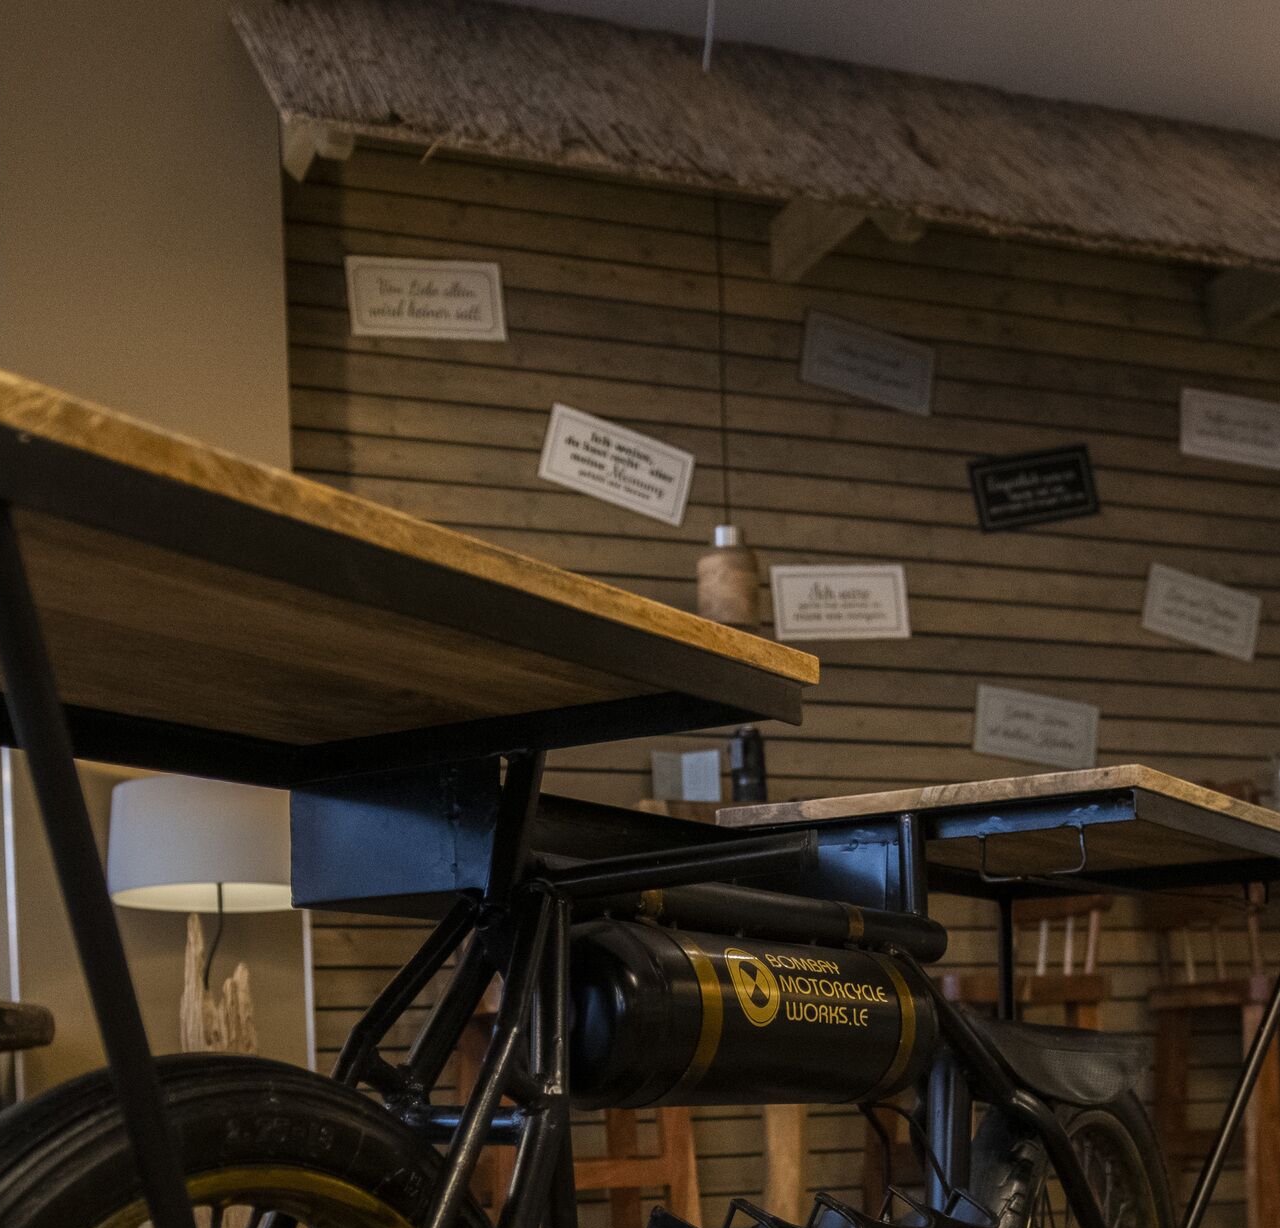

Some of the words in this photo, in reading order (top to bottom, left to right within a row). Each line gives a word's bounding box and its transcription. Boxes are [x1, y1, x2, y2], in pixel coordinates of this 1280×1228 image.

[564, 434, 580, 448] du
[583, 440, 607, 458] hast
[590, 431, 611, 448] Ich
[764, 953, 841, 975] BOMBAY
[778, 974, 889, 1003] MOTORCYCLE
[785, 1000, 869, 1027] WORKS.LE
